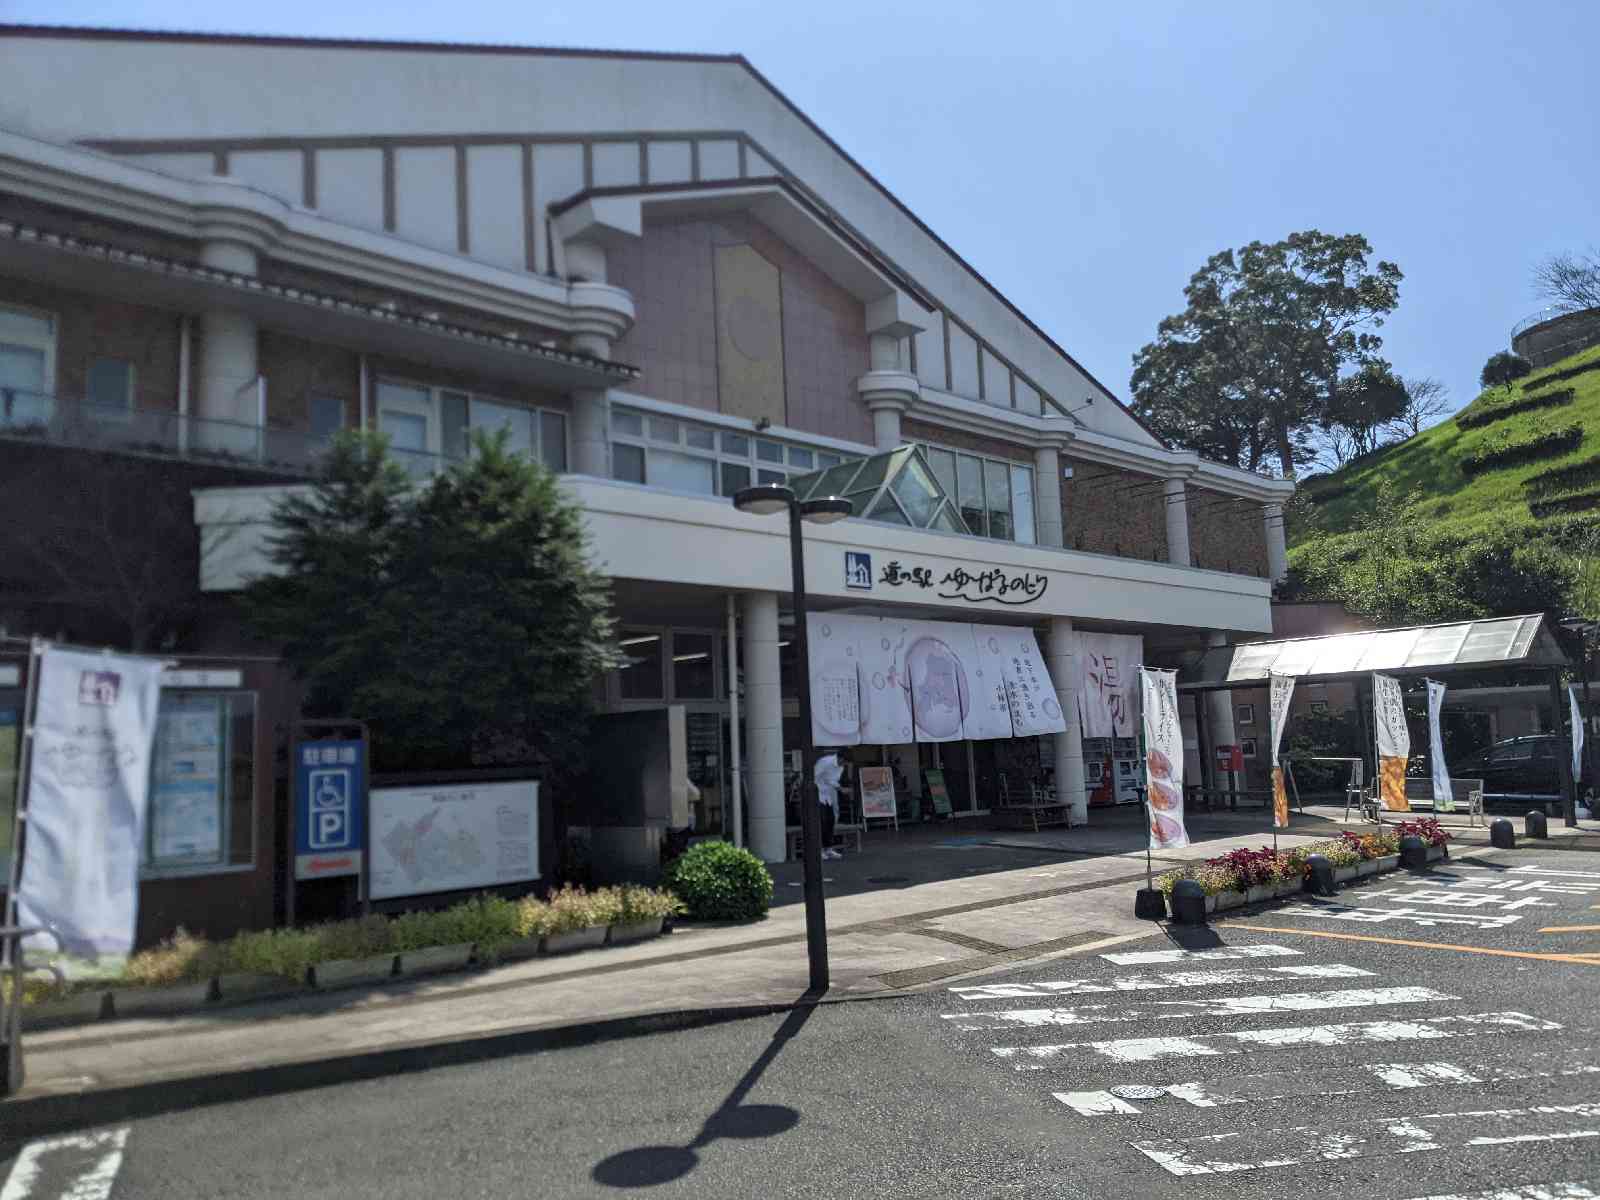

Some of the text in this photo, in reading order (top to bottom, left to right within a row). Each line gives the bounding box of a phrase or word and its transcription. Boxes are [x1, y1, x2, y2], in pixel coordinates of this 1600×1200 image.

[879, 560, 934, 588] 道の駅
[319, 813, 342, 844] P
